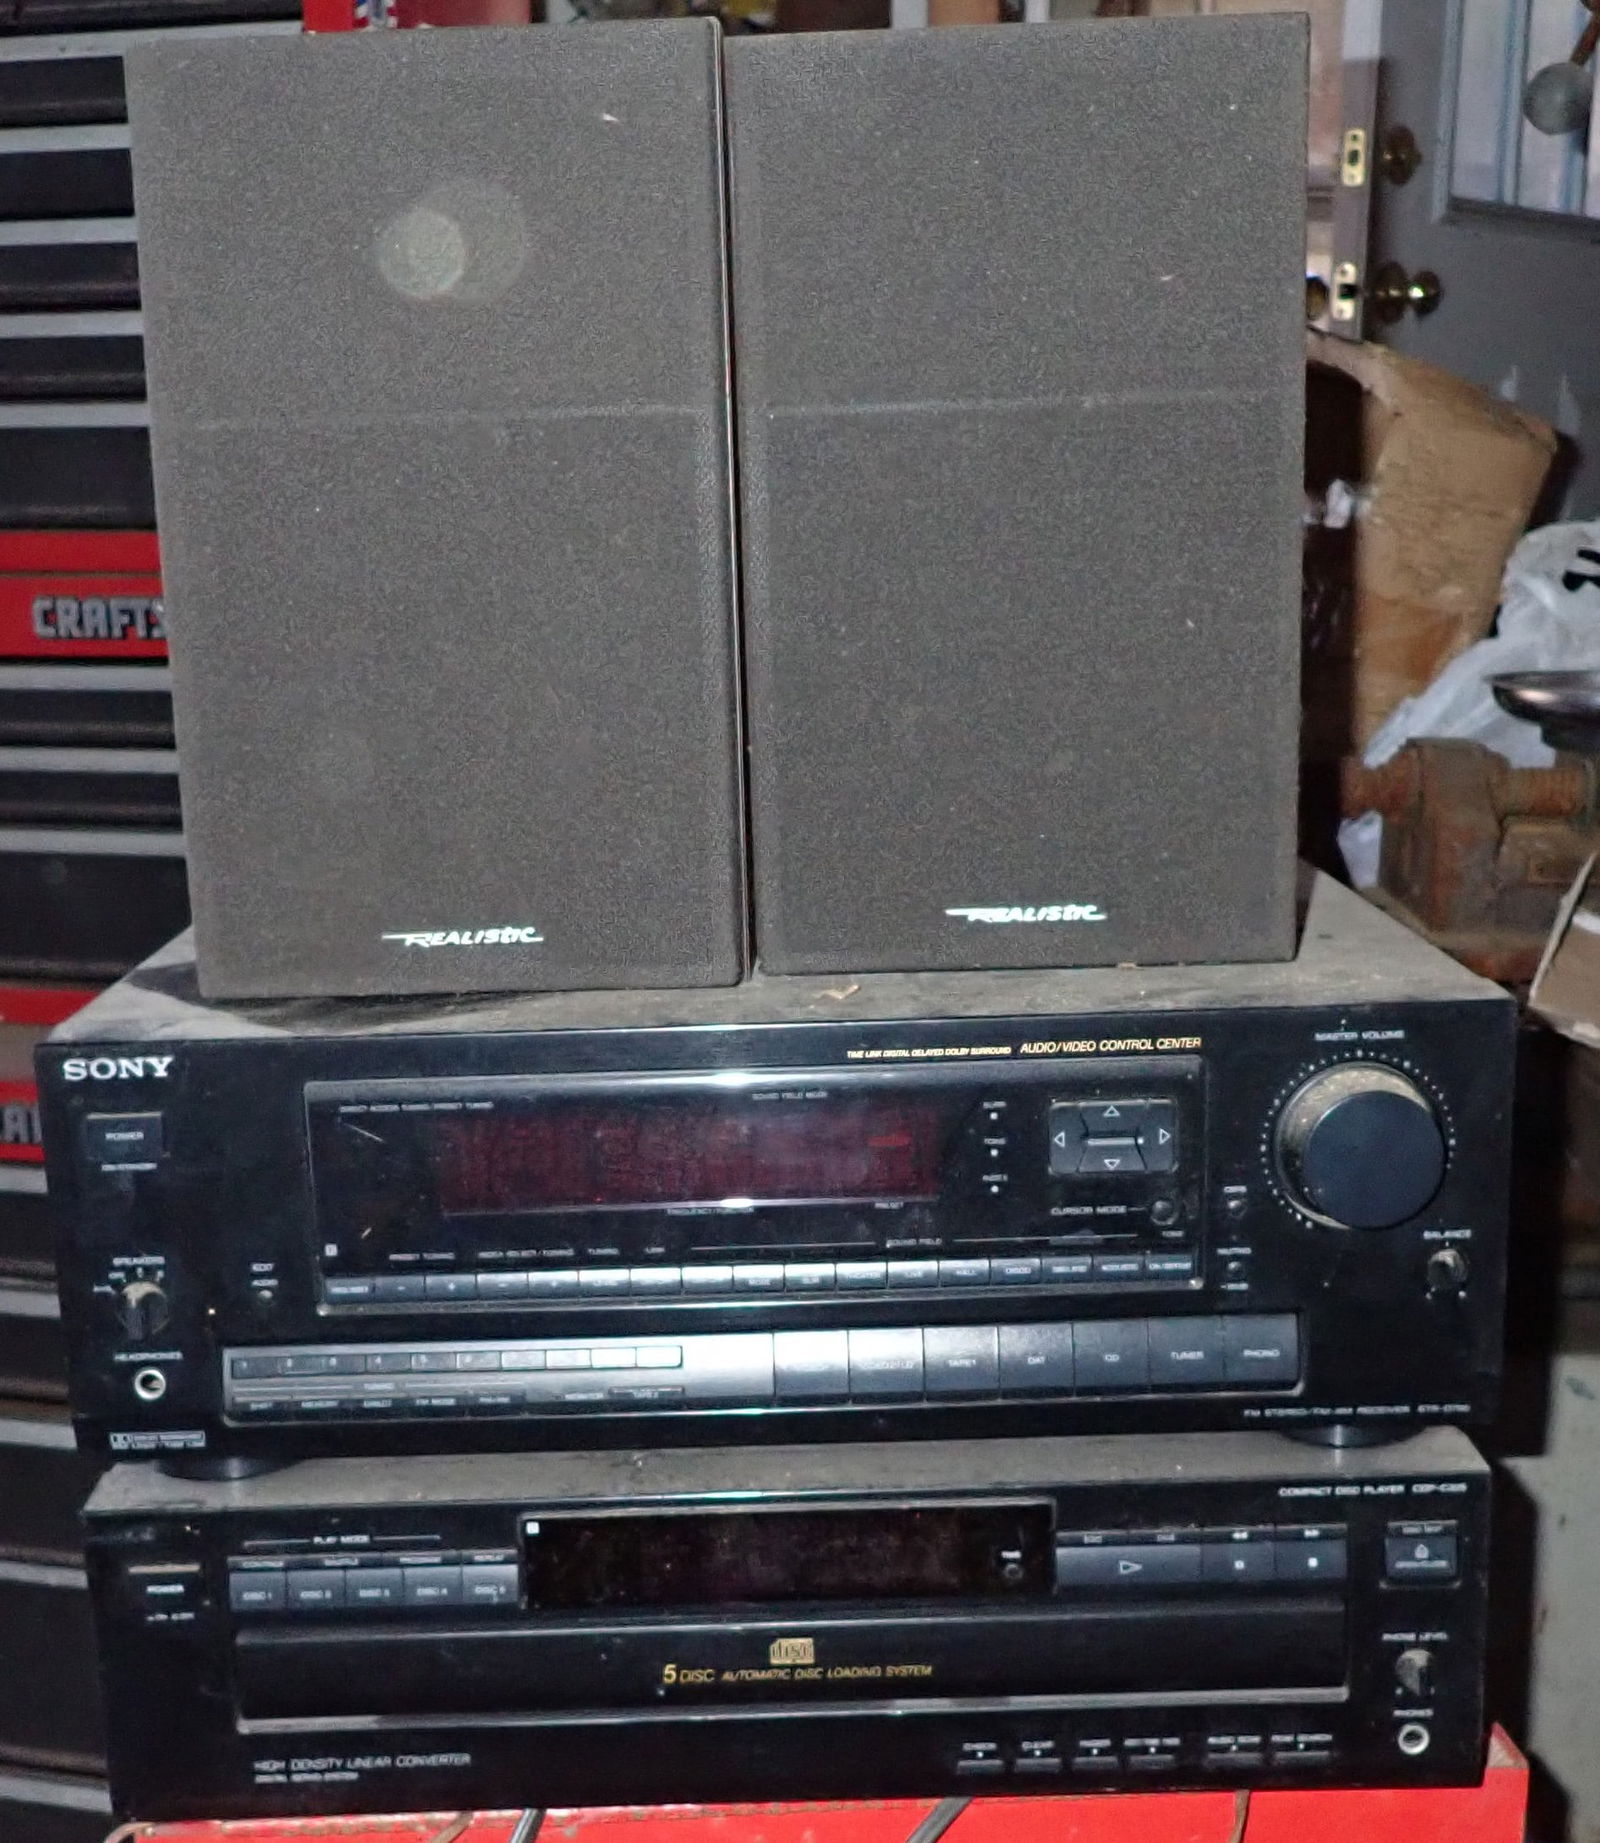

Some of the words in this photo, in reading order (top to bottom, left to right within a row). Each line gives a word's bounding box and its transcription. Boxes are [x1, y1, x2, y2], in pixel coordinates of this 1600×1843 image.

[945, 904, 1108, 922] REALISTIC
[381, 927, 544, 948] REALISTIC
[1361, 1030, 1405, 1039] VOLUME
[1019, 1040, 1097, 1054] AUDIO/VIDEO
[1099, 1038, 1154, 1051] CONTROL
[1156, 1037, 1201, 1050] CENTER
[63, 1055, 173, 1080] SONY
[1051, 1206, 1093, 1216] CURSOR
[1096, 1205, 1127, 1214] MODE
[1170, 1350, 1204, 1360] TUNER
[1279, 1486, 1332, 1497] COMPACT
[1363, 1484, 1404, 1494] PLAYER
[664, 1664, 677, 1684] 5
[680, 1669, 716, 1683] DISC
[721, 1669, 792, 1682] AUTOMATIC
[795, 1668, 824, 1680] DISC
[827, 1666, 883, 1679] LOADING
[886, 1665, 933, 1677] SYSTEM
[254, 1760, 286, 1772] HIGH
[290, 1757, 343, 1771] DENSITY
[347, 1756, 392, 1769] LINEAR
[395, 1752, 472, 1768] CONVERTER
